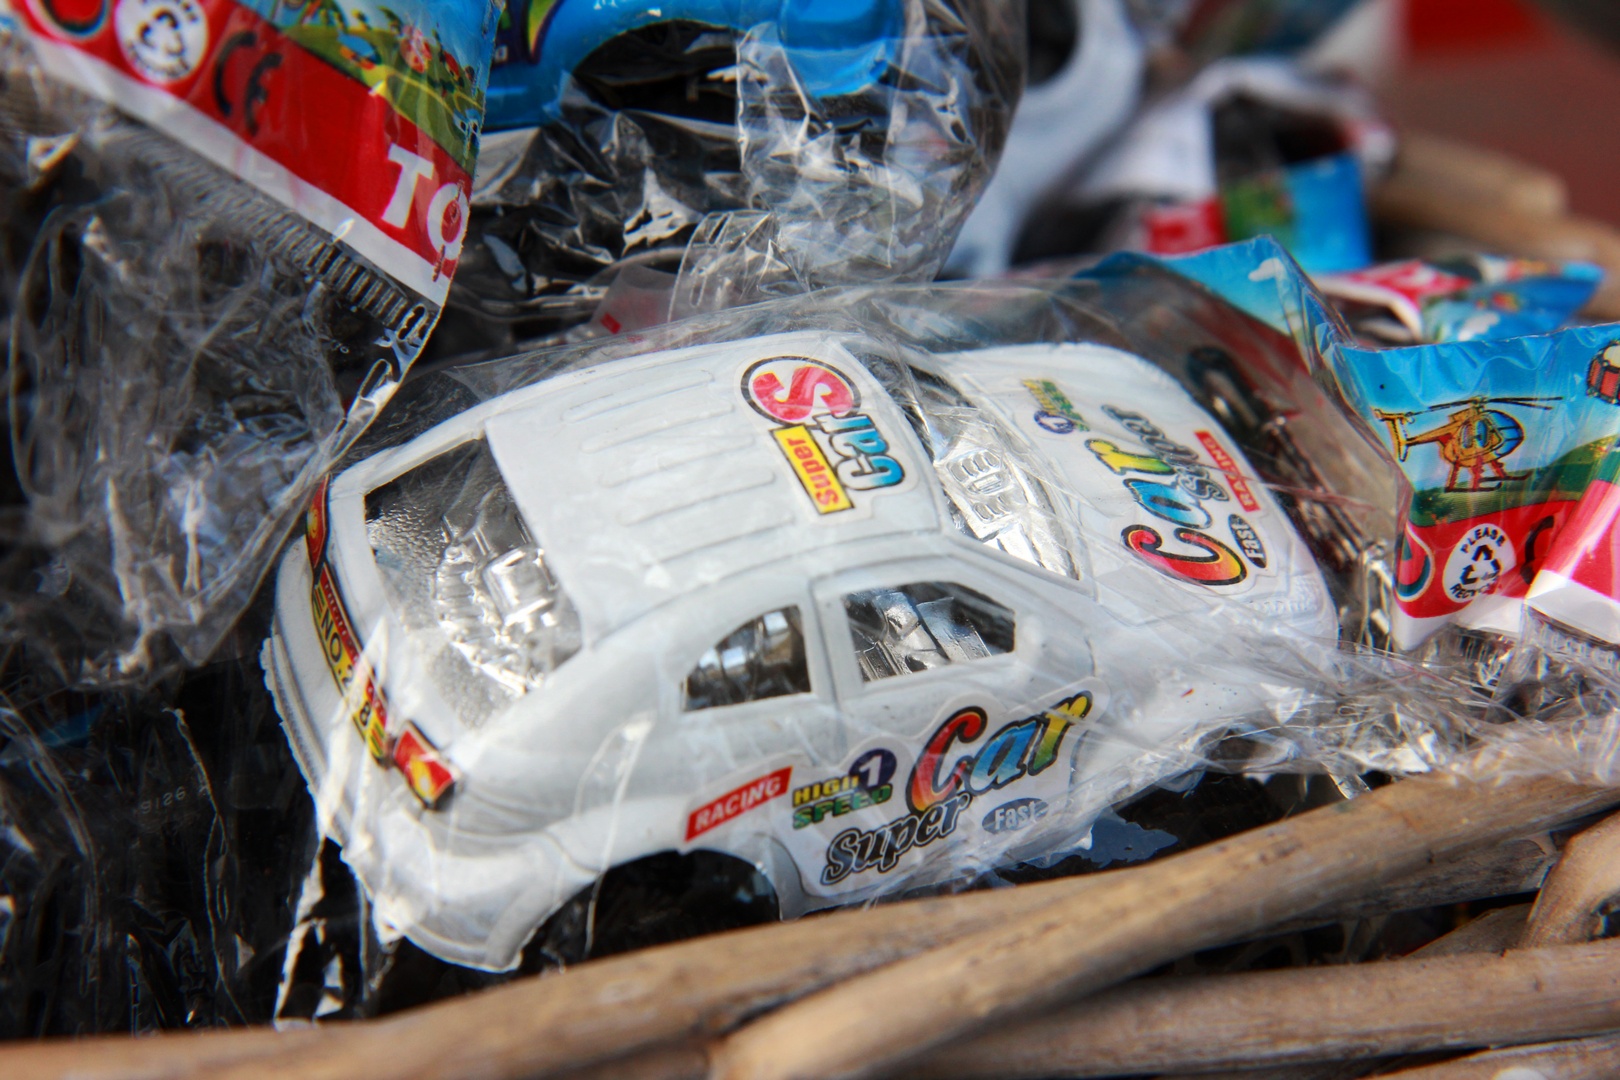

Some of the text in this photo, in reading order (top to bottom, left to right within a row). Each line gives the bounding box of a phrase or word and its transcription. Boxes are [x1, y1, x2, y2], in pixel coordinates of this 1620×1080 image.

[786, 437, 839, 506] Super
[812, 413, 905, 491] Car
[1200, 436, 1255, 509] RACING
[1084, 438, 1248, 586] Car
[1234, 519, 1265, 561] Fast
[1460, 526, 1506, 554] PLEASE
[858, 754, 883, 789] 1
[905, 689, 1093, 816] Car
[692, 772, 784, 833] RACING
[793, 774, 860, 809] HIGH
[793, 783, 893, 831] SPEED
[993, 801, 1040, 833] Fast
[820, 792, 973, 886] Super
